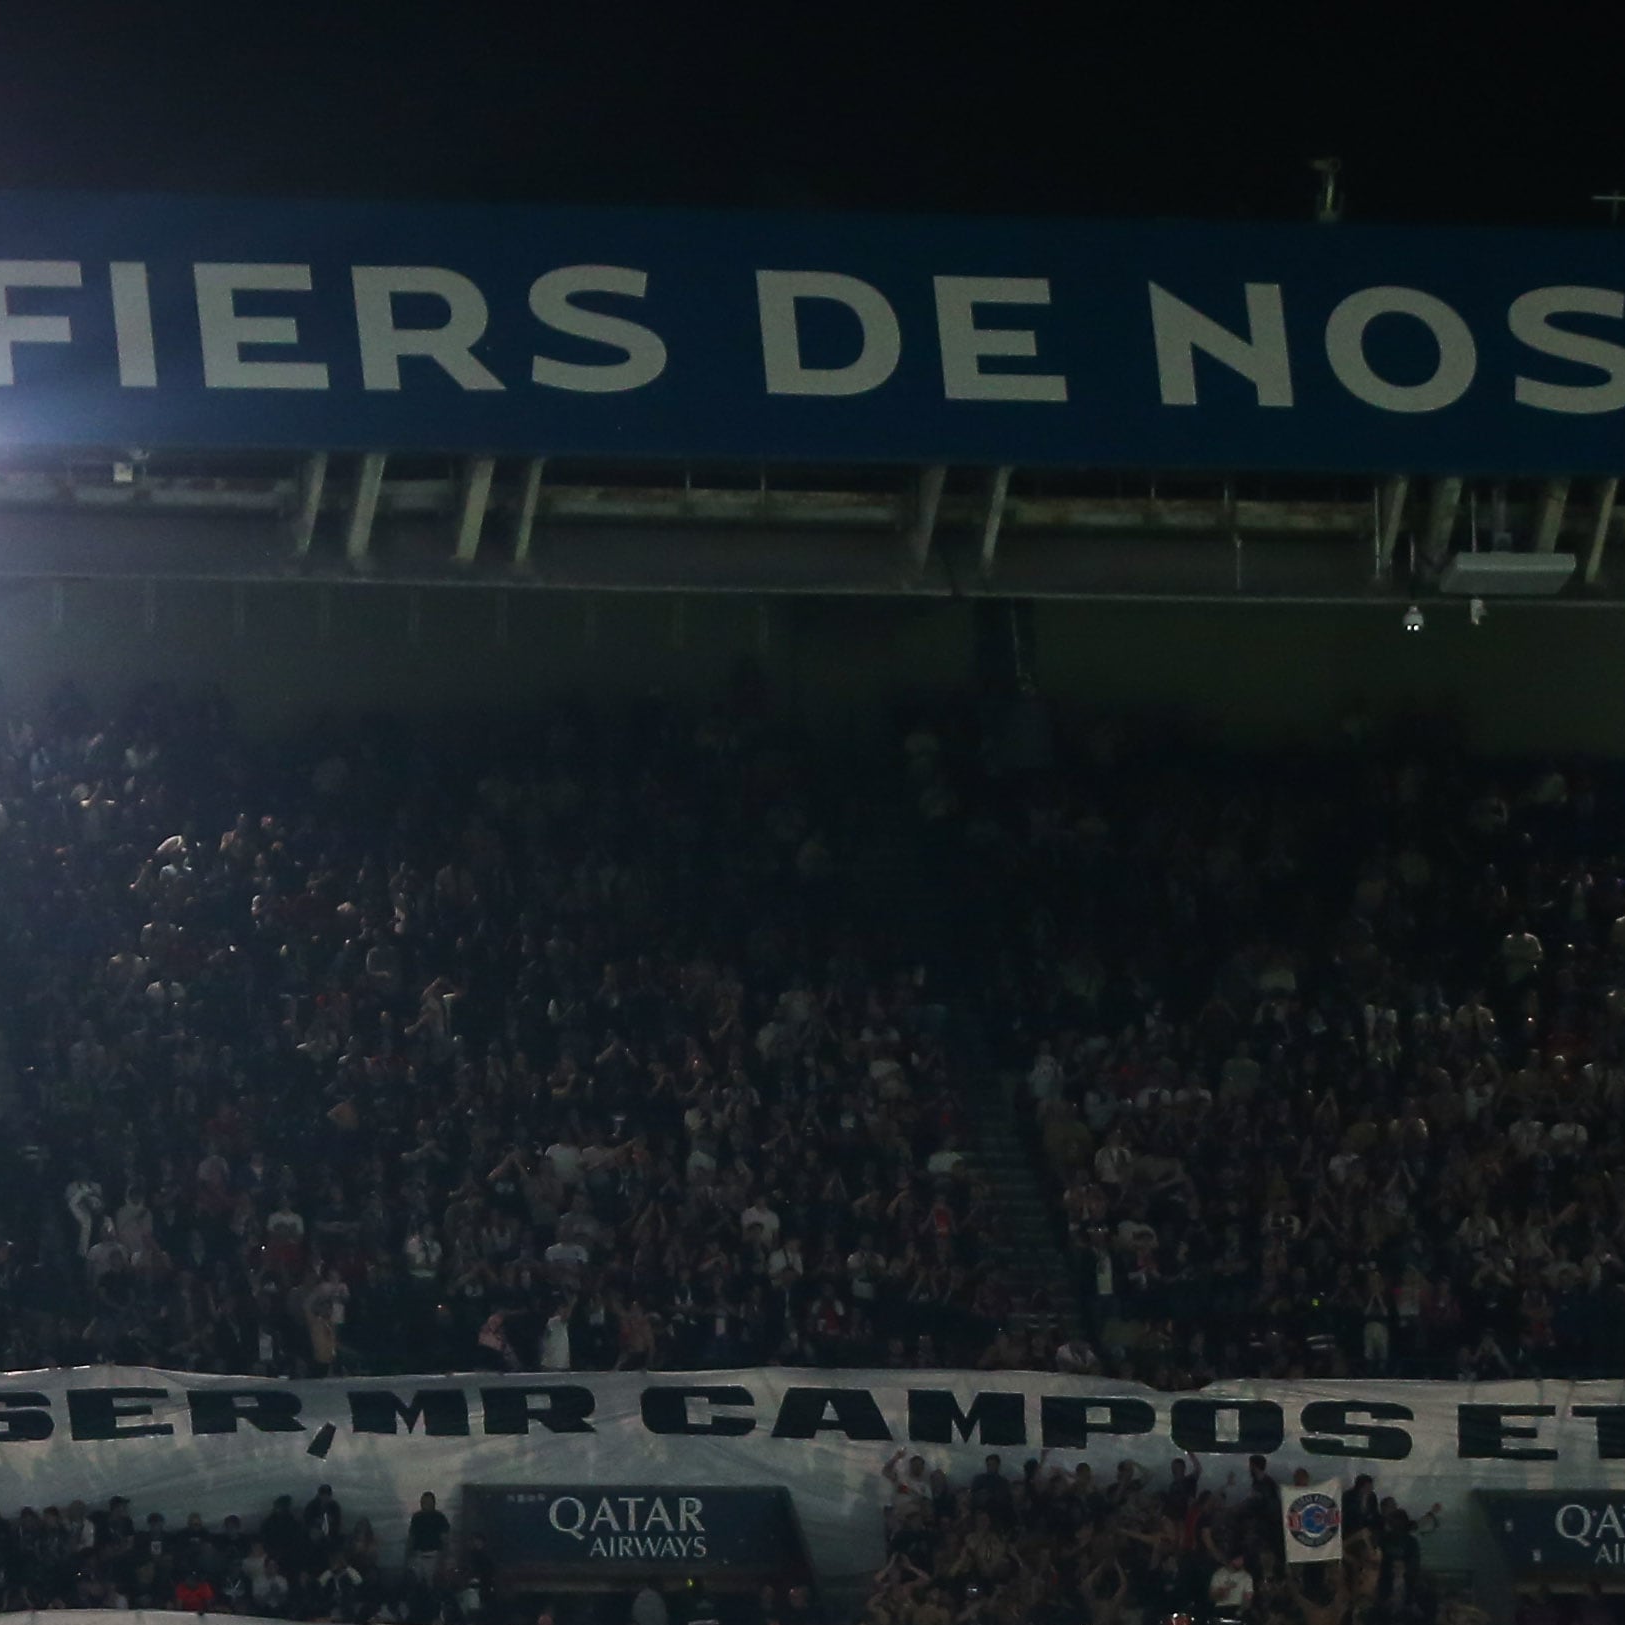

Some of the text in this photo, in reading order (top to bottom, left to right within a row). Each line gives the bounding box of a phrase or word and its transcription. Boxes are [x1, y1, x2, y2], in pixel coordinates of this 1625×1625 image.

[755, 269, 1070, 404] DE
[347, 1385, 597, 1437] MR
[639, 1385, 1414, 1459] CAMPOS
[548, 1496, 706, 1541] QATAR
[589, 1536, 707, 1558] AIRWAYS
